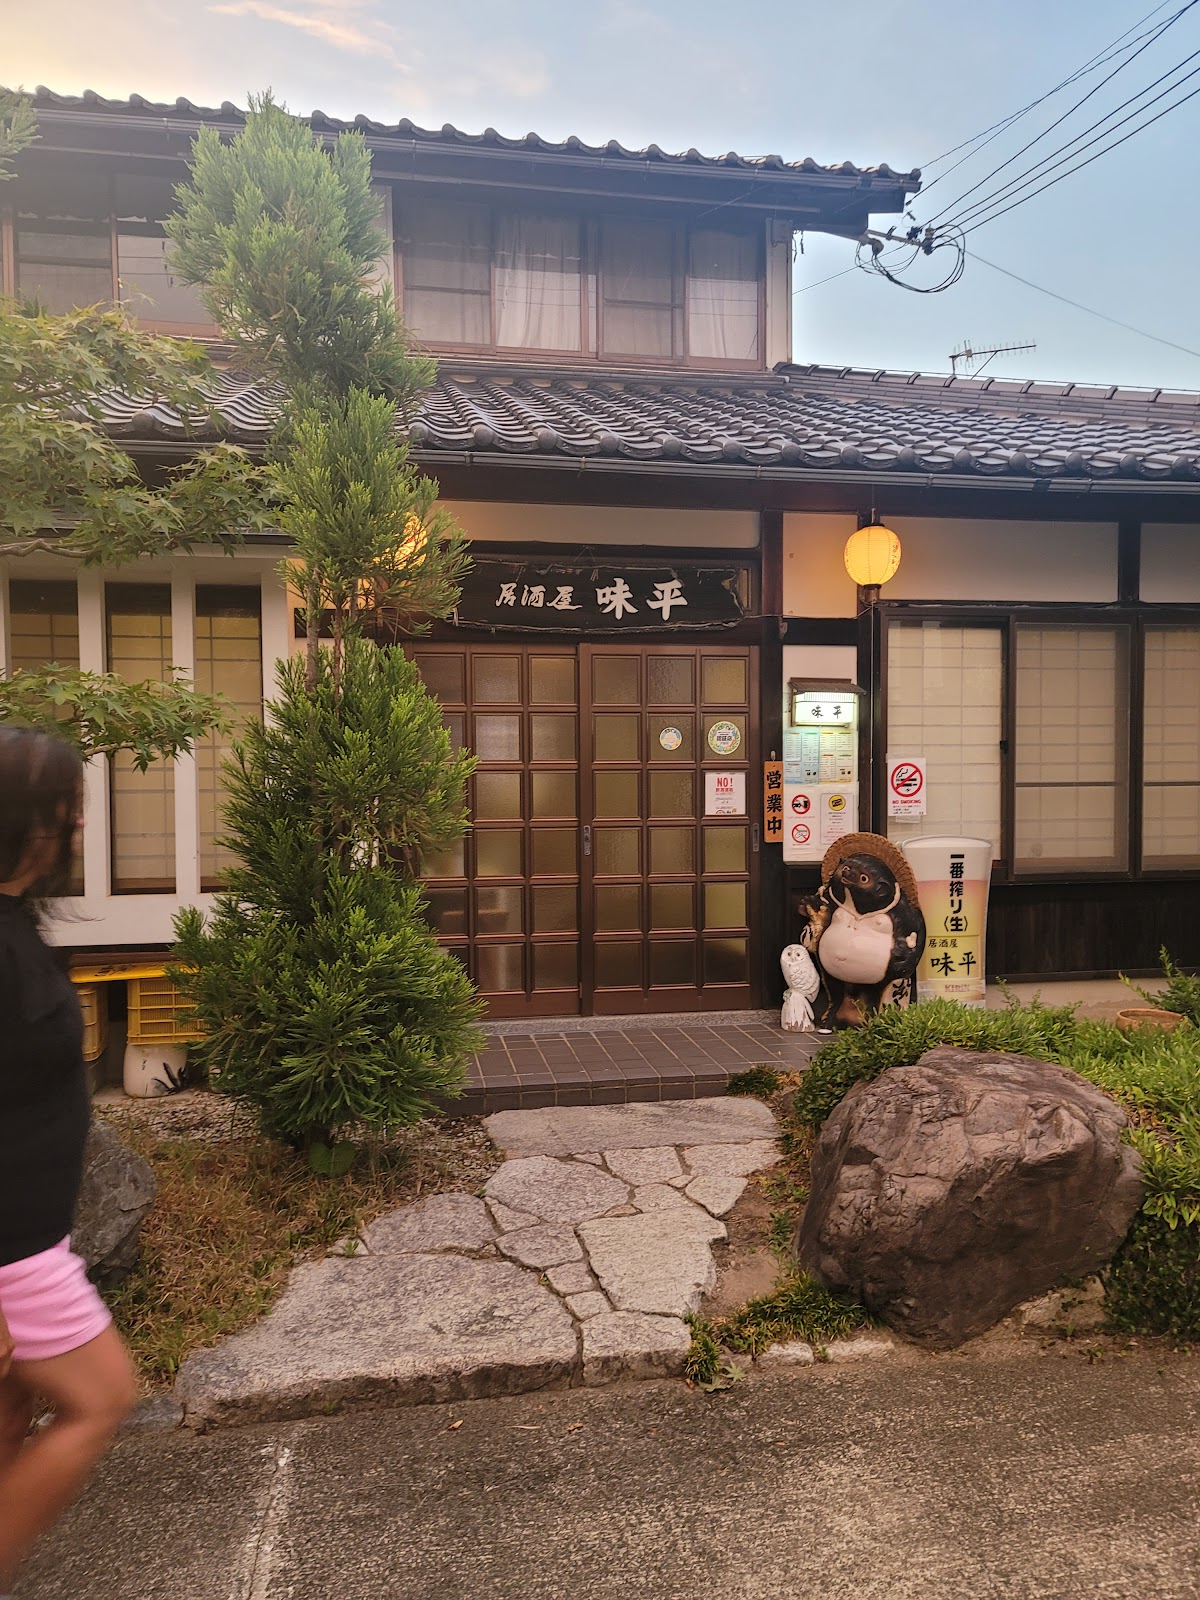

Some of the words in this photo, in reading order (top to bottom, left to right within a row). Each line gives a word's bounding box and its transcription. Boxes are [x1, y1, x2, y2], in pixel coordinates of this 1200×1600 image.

[495, 582, 583, 611] 居酒屋
[595, 577, 688, 621] 味平
[811, 705, 842, 719] 味平
[716, 777, 733, 787] NO!
[766, 770, 782, 834] 営業中
[928, 938, 958, 948] 居酒屋
[930, 951, 977, 976] 味平
